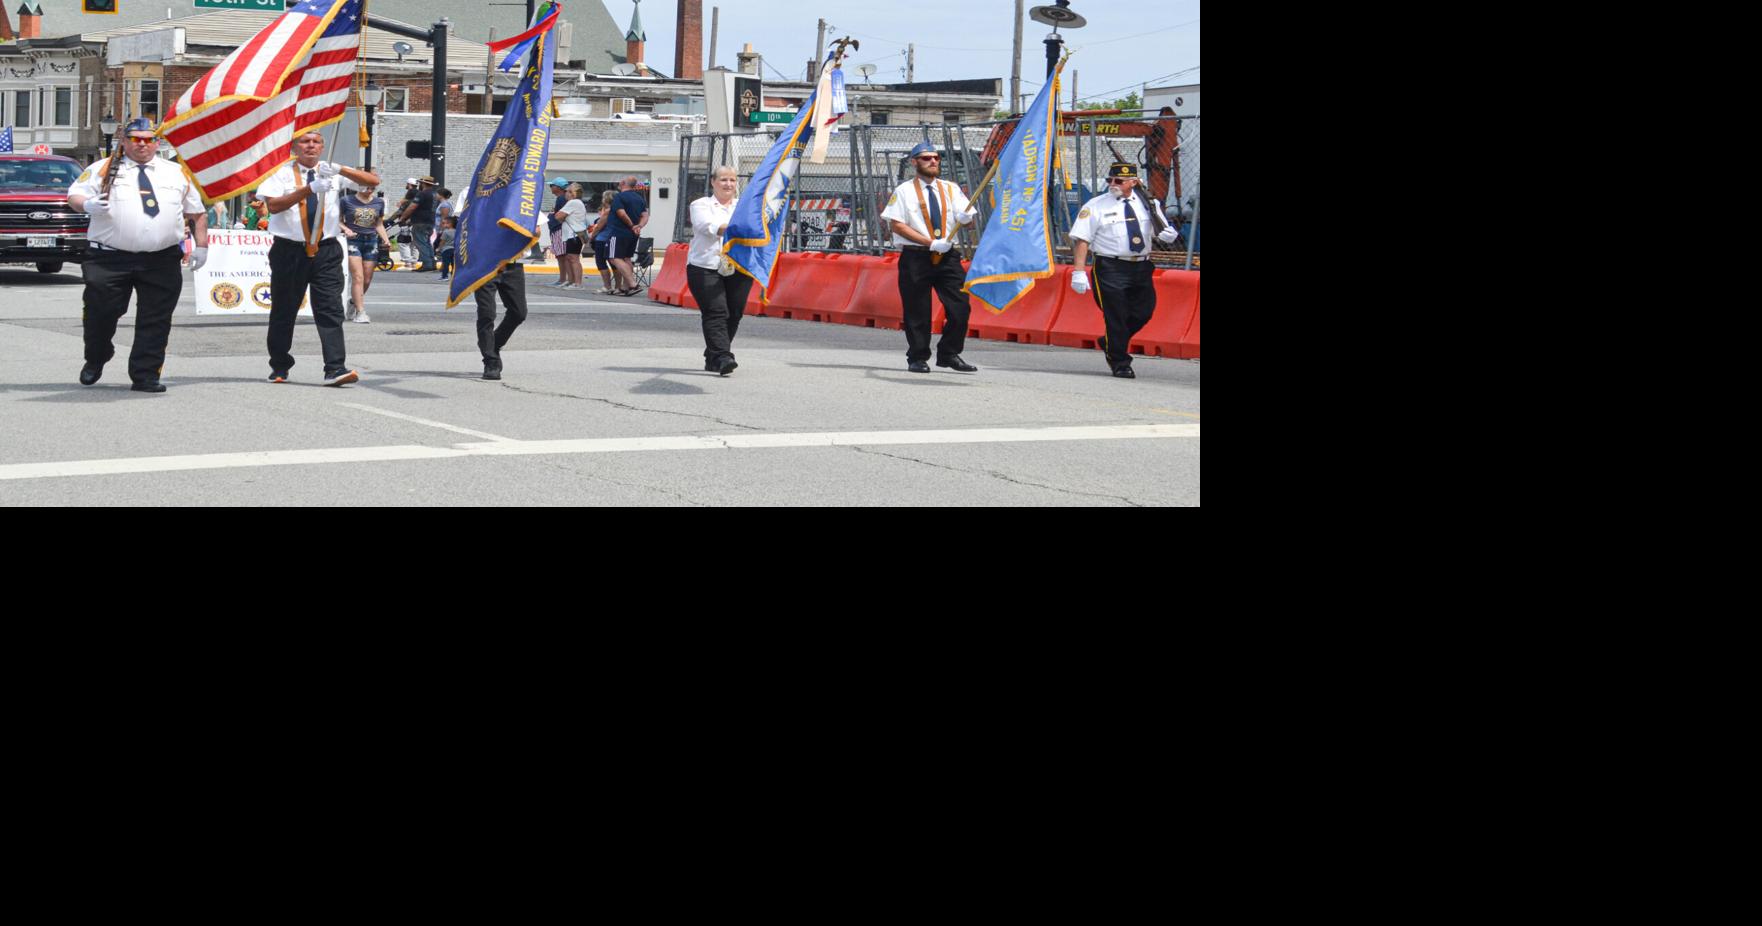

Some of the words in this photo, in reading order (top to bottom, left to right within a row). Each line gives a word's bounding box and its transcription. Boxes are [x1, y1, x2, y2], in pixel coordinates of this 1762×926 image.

[767, 113, 781, 122] 10th
[524, 128, 547, 172] EDWARD
[520, 180, 536, 217] FRANK
[1008, 208, 1027, 231] 451
